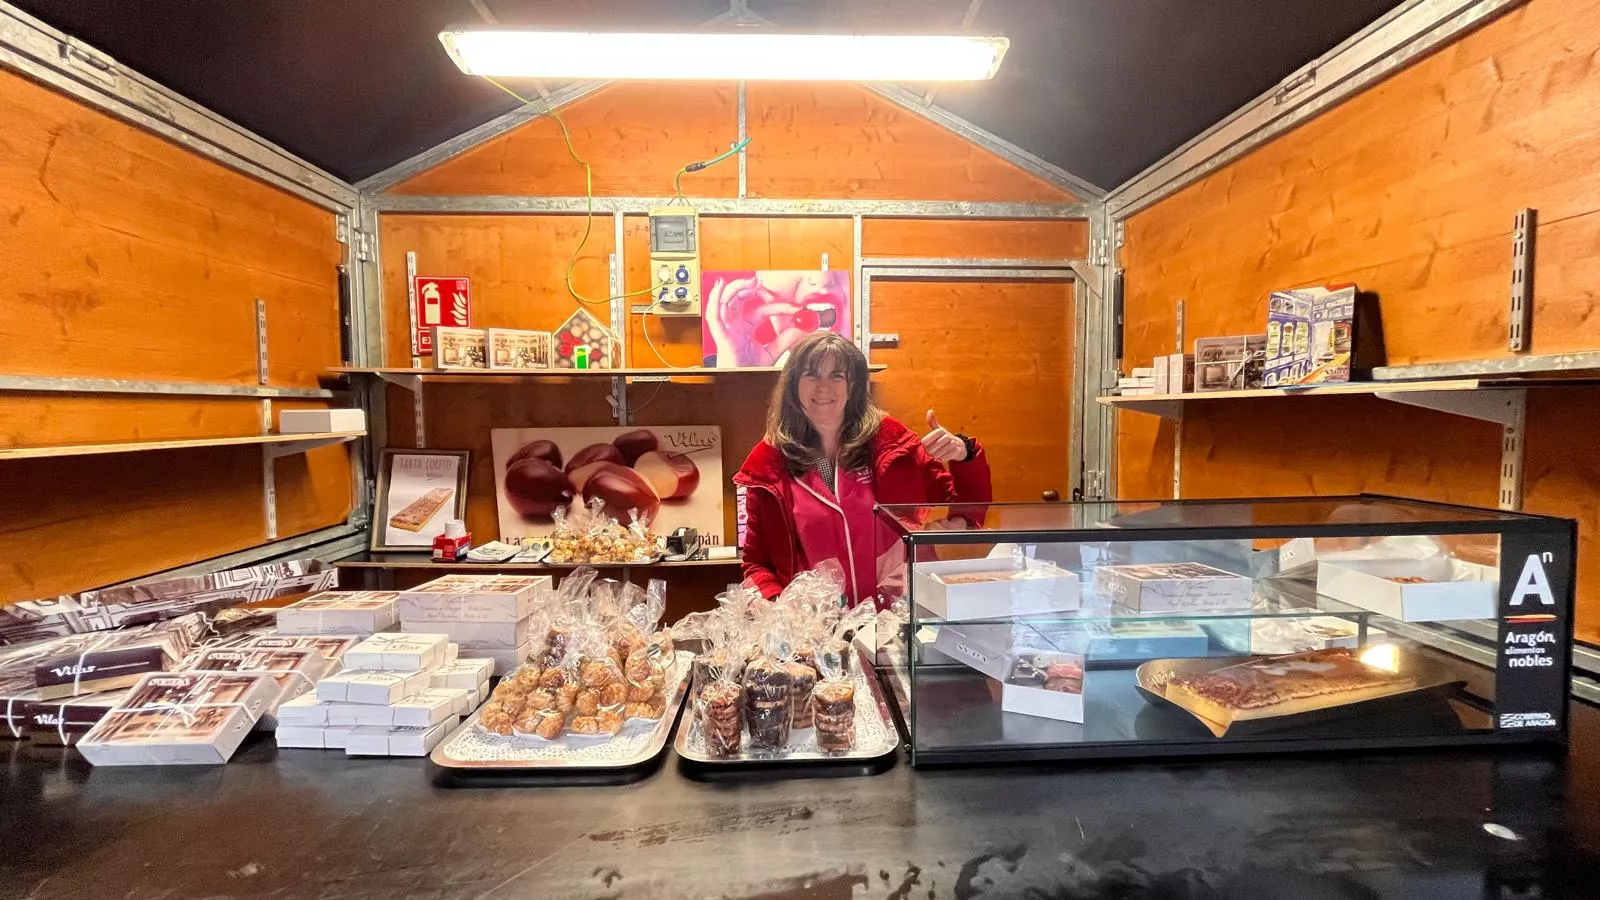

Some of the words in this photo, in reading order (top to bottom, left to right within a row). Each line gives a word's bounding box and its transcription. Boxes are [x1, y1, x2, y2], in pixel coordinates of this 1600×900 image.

[664, 431, 717, 451] Vilas
[1505, 631, 1556, 647] Aragón,
[1505, 646, 1546, 655] alimentos
[1508, 655, 1553, 668] nobles
[50, 664, 96, 678] Vilas
